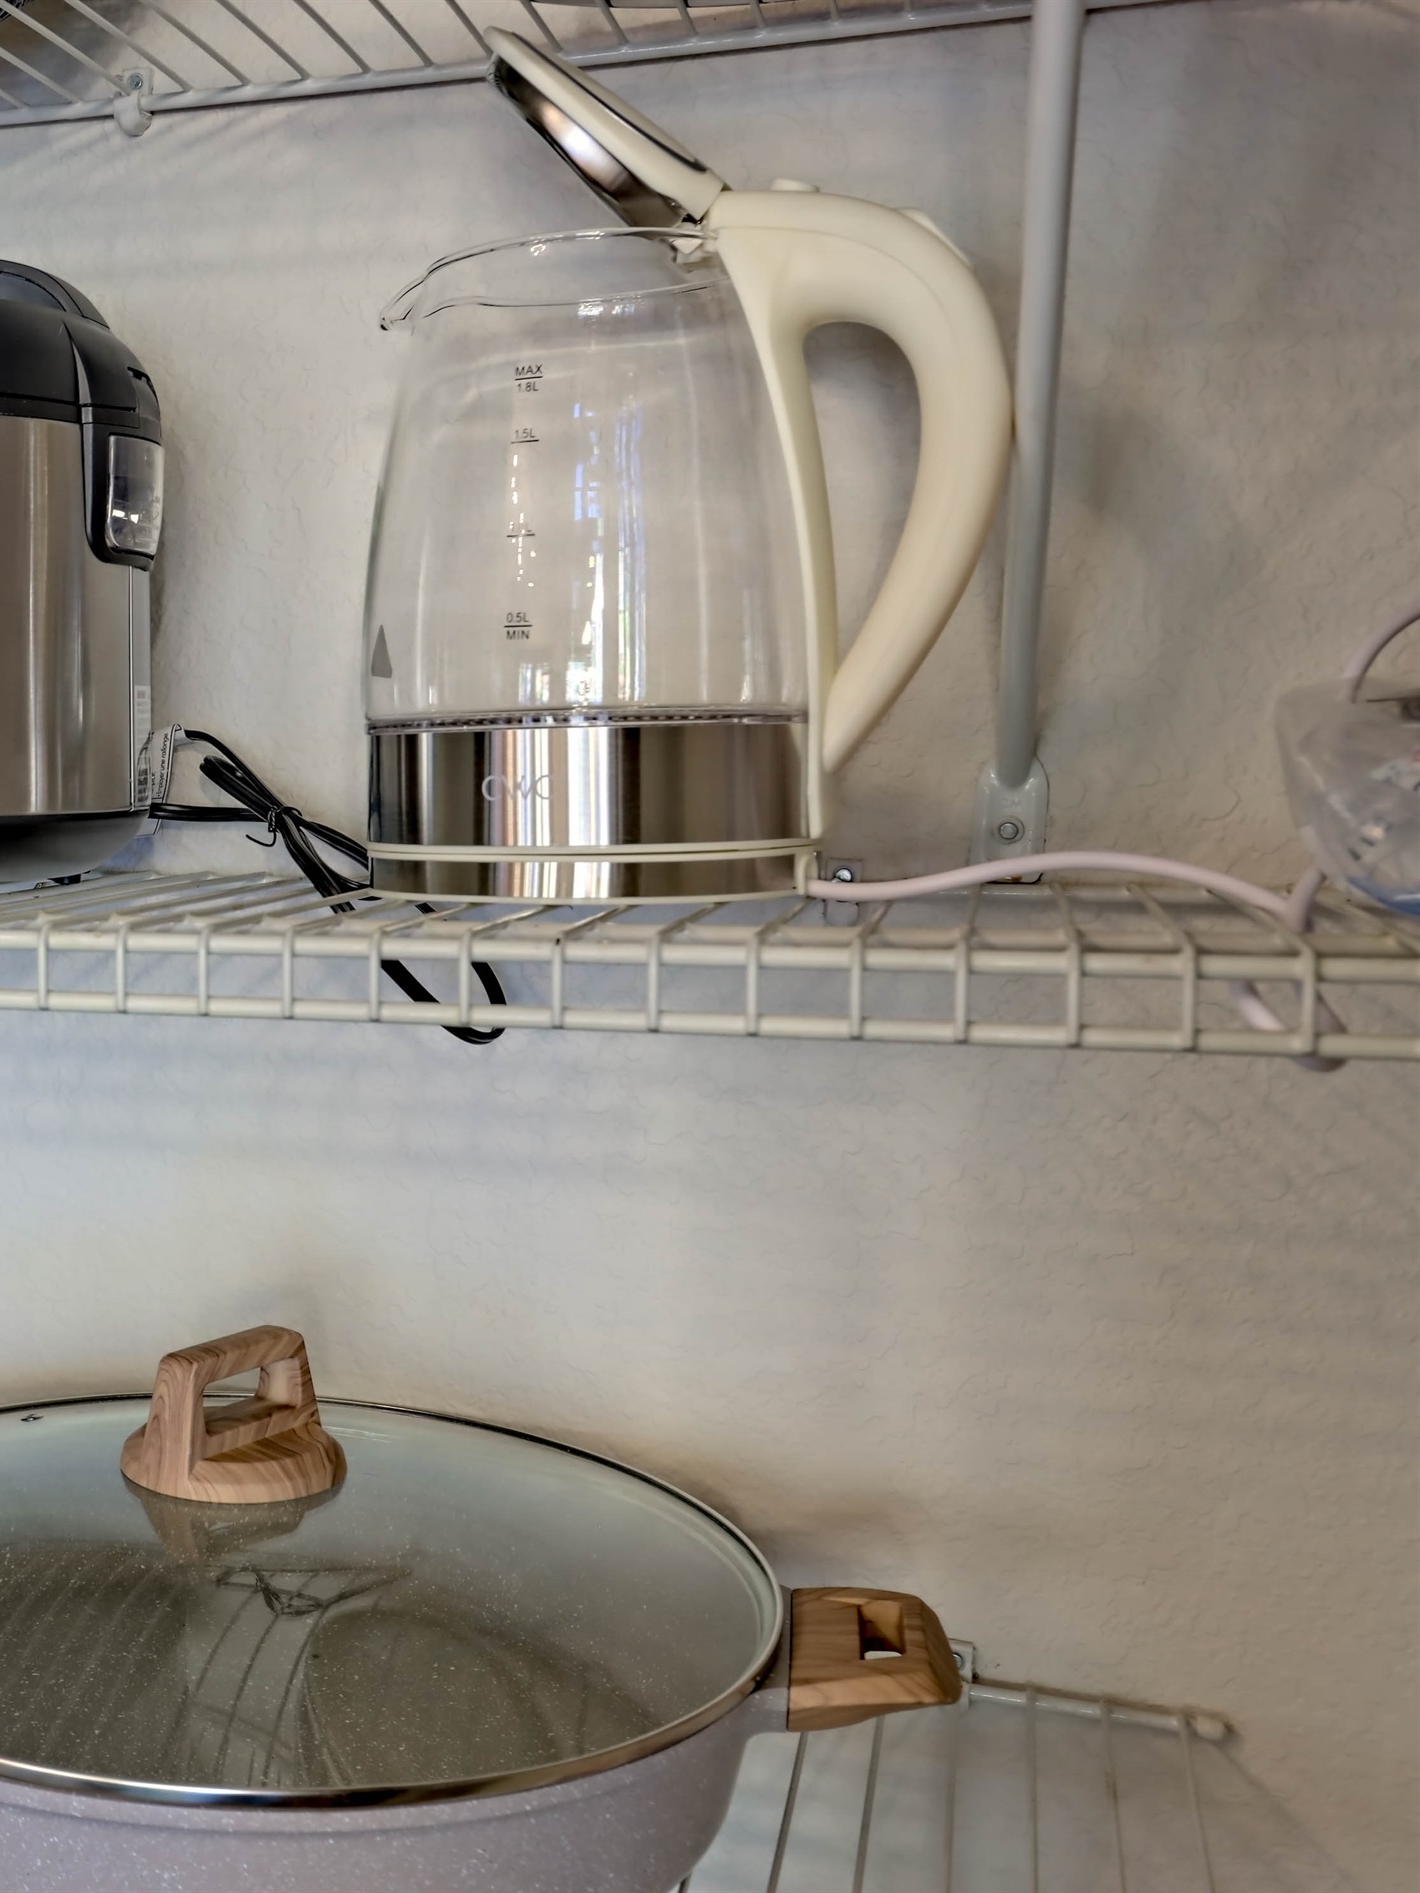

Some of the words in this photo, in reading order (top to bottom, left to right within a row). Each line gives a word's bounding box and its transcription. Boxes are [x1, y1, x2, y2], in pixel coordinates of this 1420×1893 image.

[515, 364, 543, 376] MAX
[516, 381, 539, 393] 1.8L
[514, 428, 536, 440] 1.5L
[505, 612, 529, 624] 0.5L
[506, 630, 530, 640] MIN
